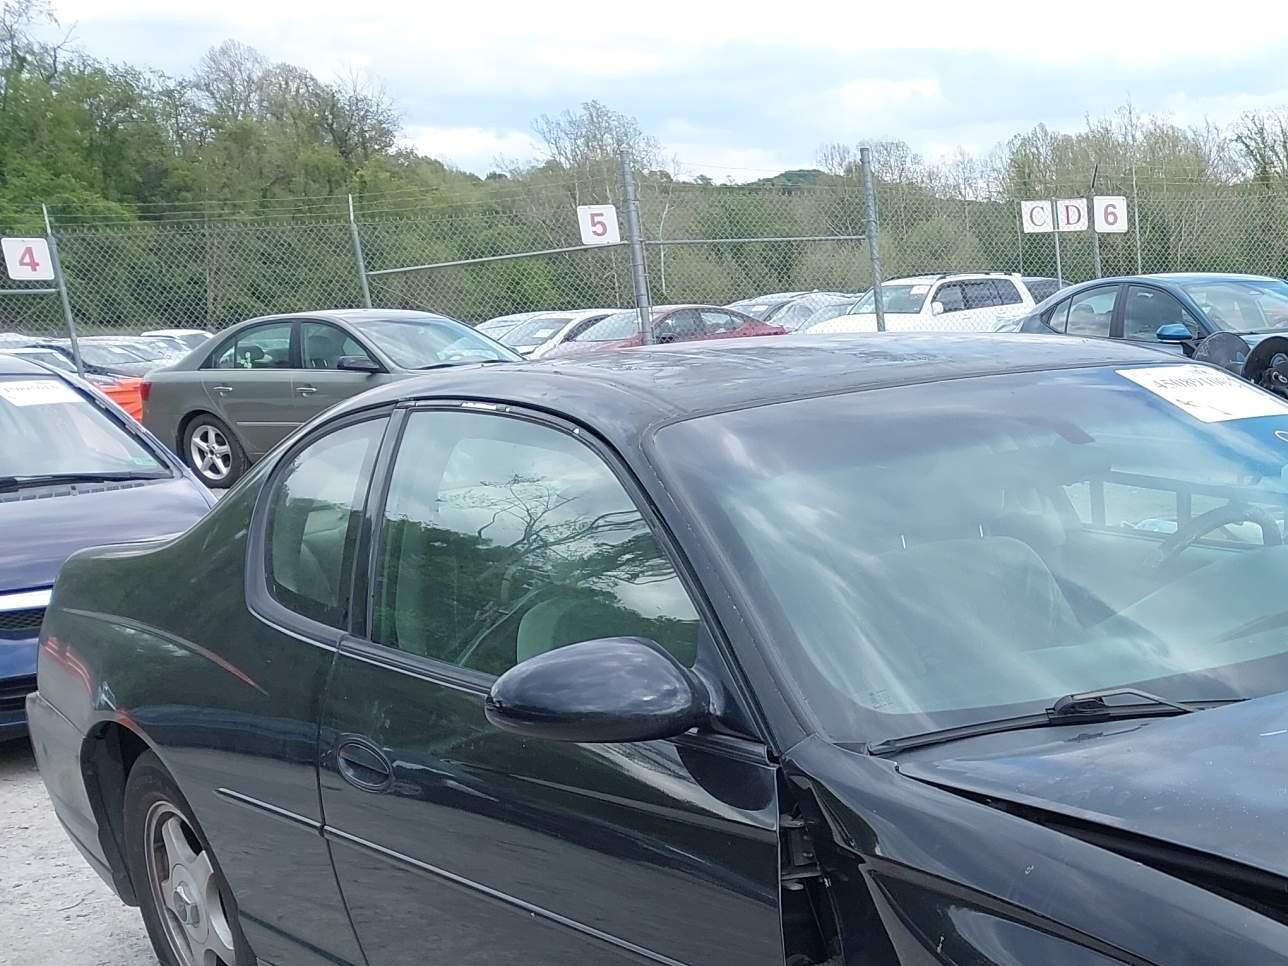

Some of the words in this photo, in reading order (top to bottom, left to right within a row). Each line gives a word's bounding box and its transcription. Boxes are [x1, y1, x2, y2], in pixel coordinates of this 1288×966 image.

[590, 212, 608, 237] 5
[1029, 205, 1046, 227] C
[1064, 204, 1082, 225] D
[1103, 203, 1118, 226] 6
[18, 246, 40, 272] 4
